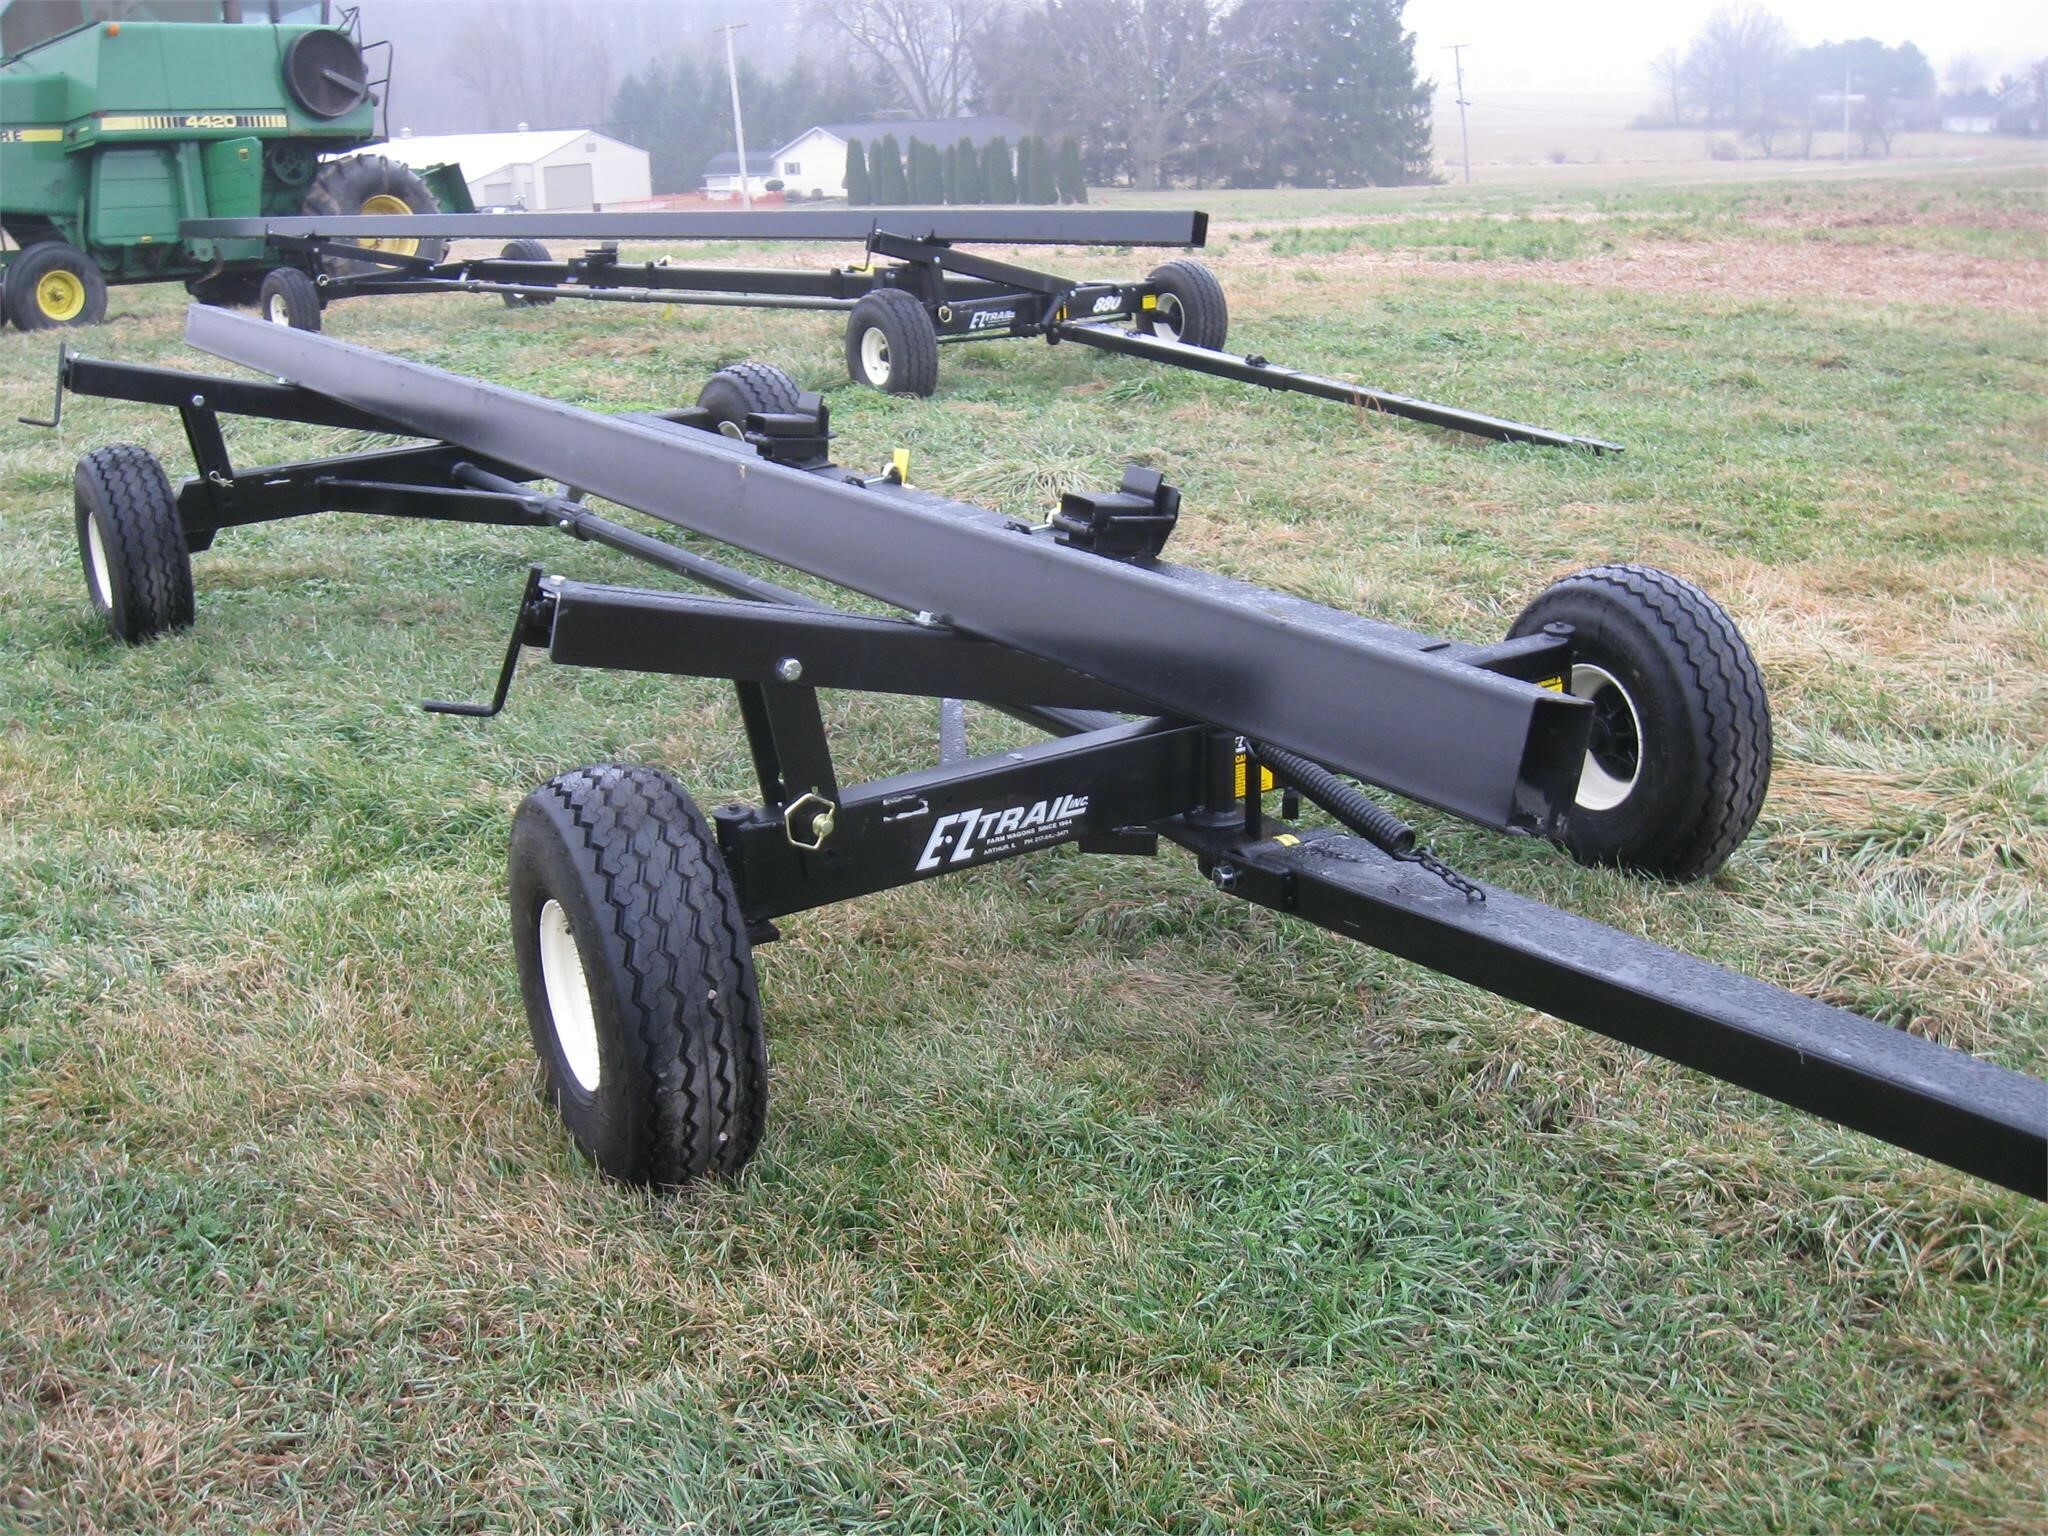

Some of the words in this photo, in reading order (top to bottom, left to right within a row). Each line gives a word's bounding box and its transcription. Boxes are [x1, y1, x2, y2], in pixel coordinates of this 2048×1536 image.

[185, 115, 237, 128] 4420
[1092, 296, 1122, 313] 880
[977, 793, 1087, 839] TRAIL
[986, 834, 1006, 845] FARM
[1007, 827, 1036, 840] WAGONS
[1037, 822, 1058, 833] SINCE
